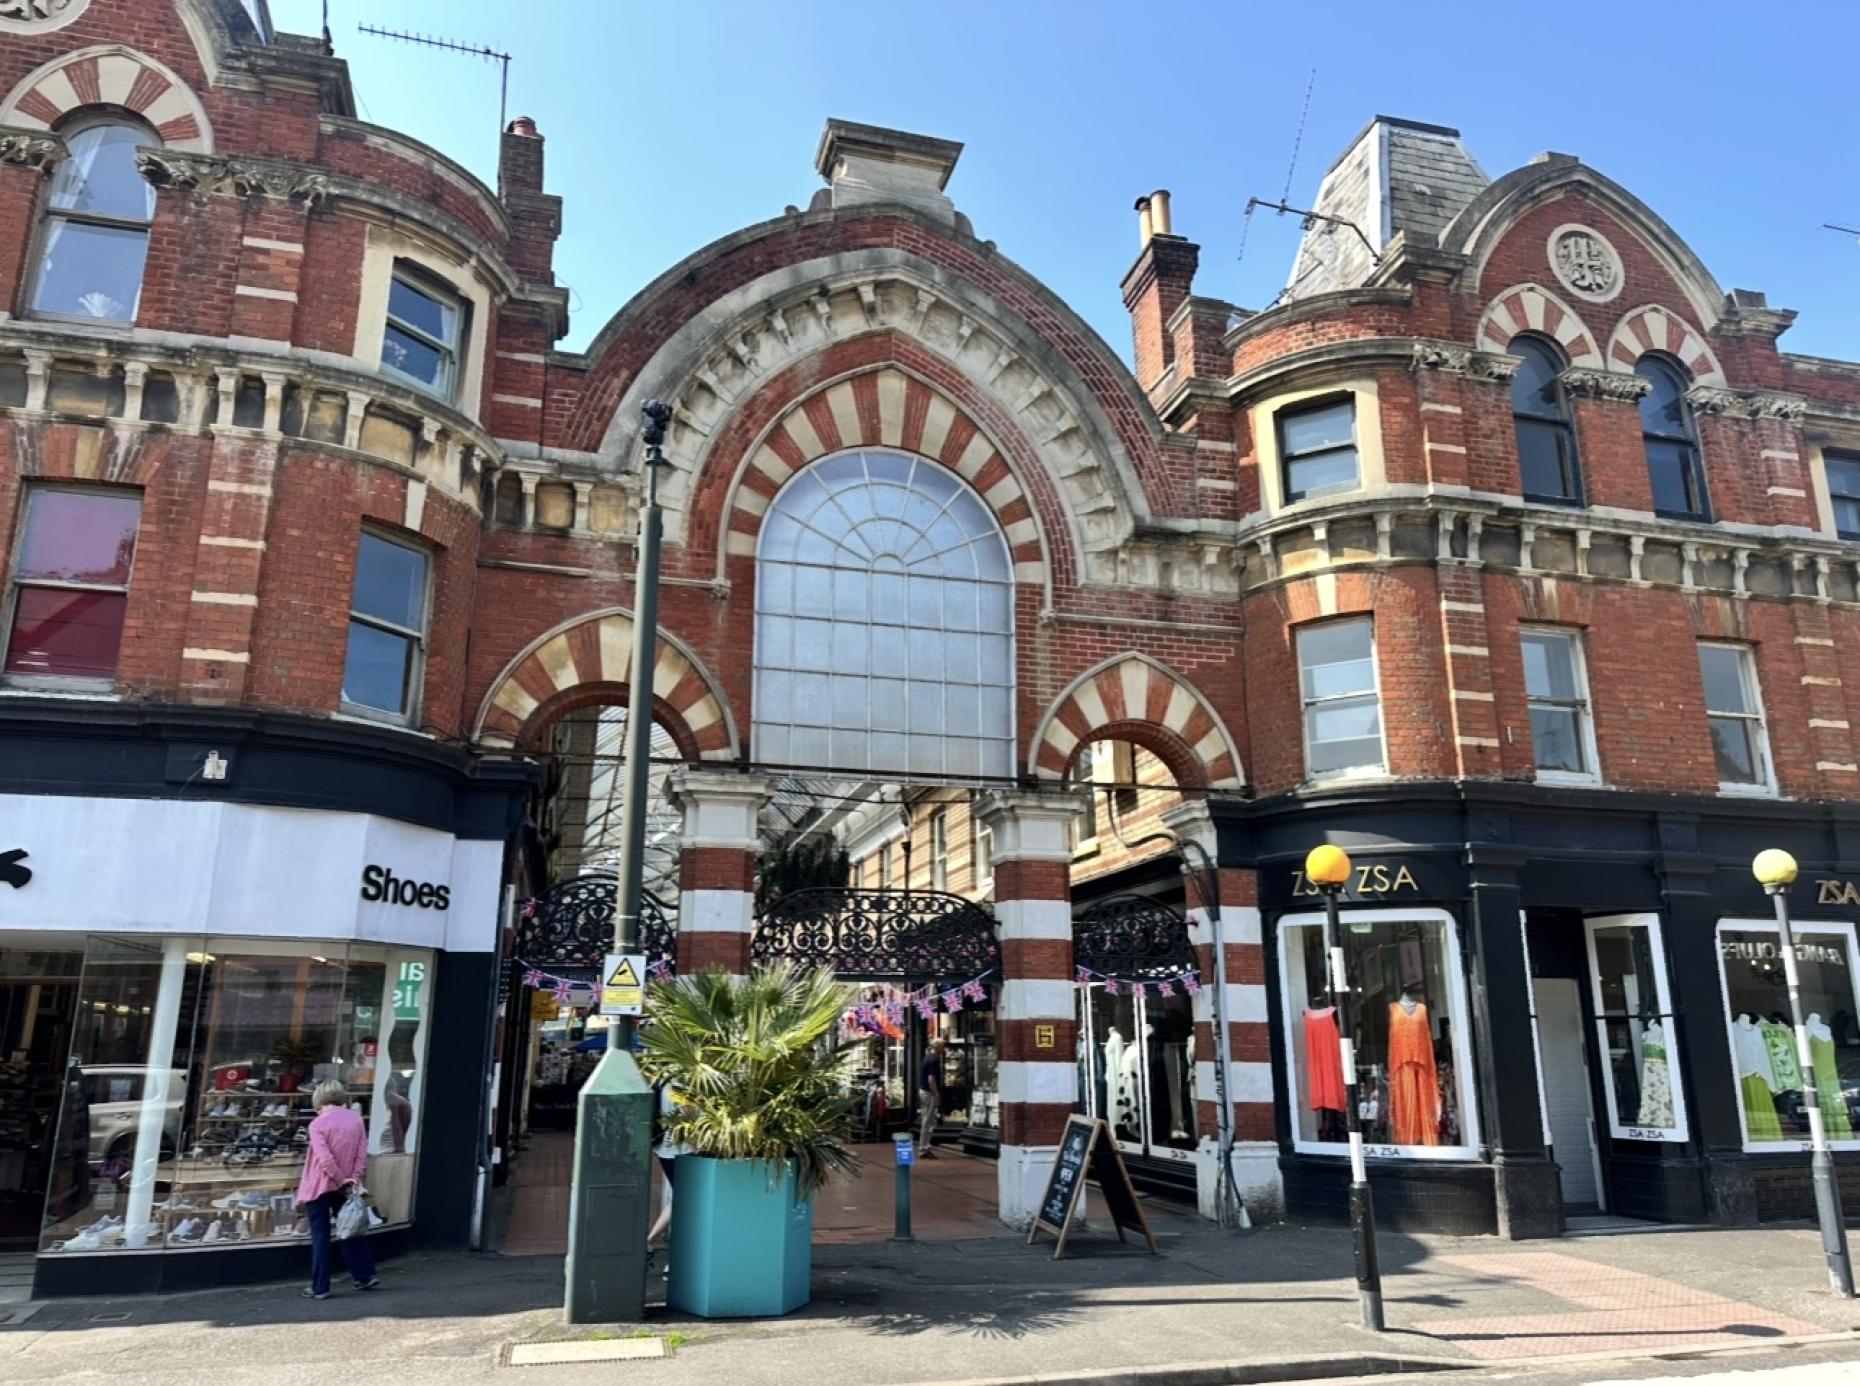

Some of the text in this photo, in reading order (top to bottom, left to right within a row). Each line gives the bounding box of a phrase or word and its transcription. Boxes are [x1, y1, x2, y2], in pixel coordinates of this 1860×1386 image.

[361, 865, 451, 911] Shoes
[1355, 865, 1419, 892] ZSA
[1815, 880, 1860, 905] ZSA
